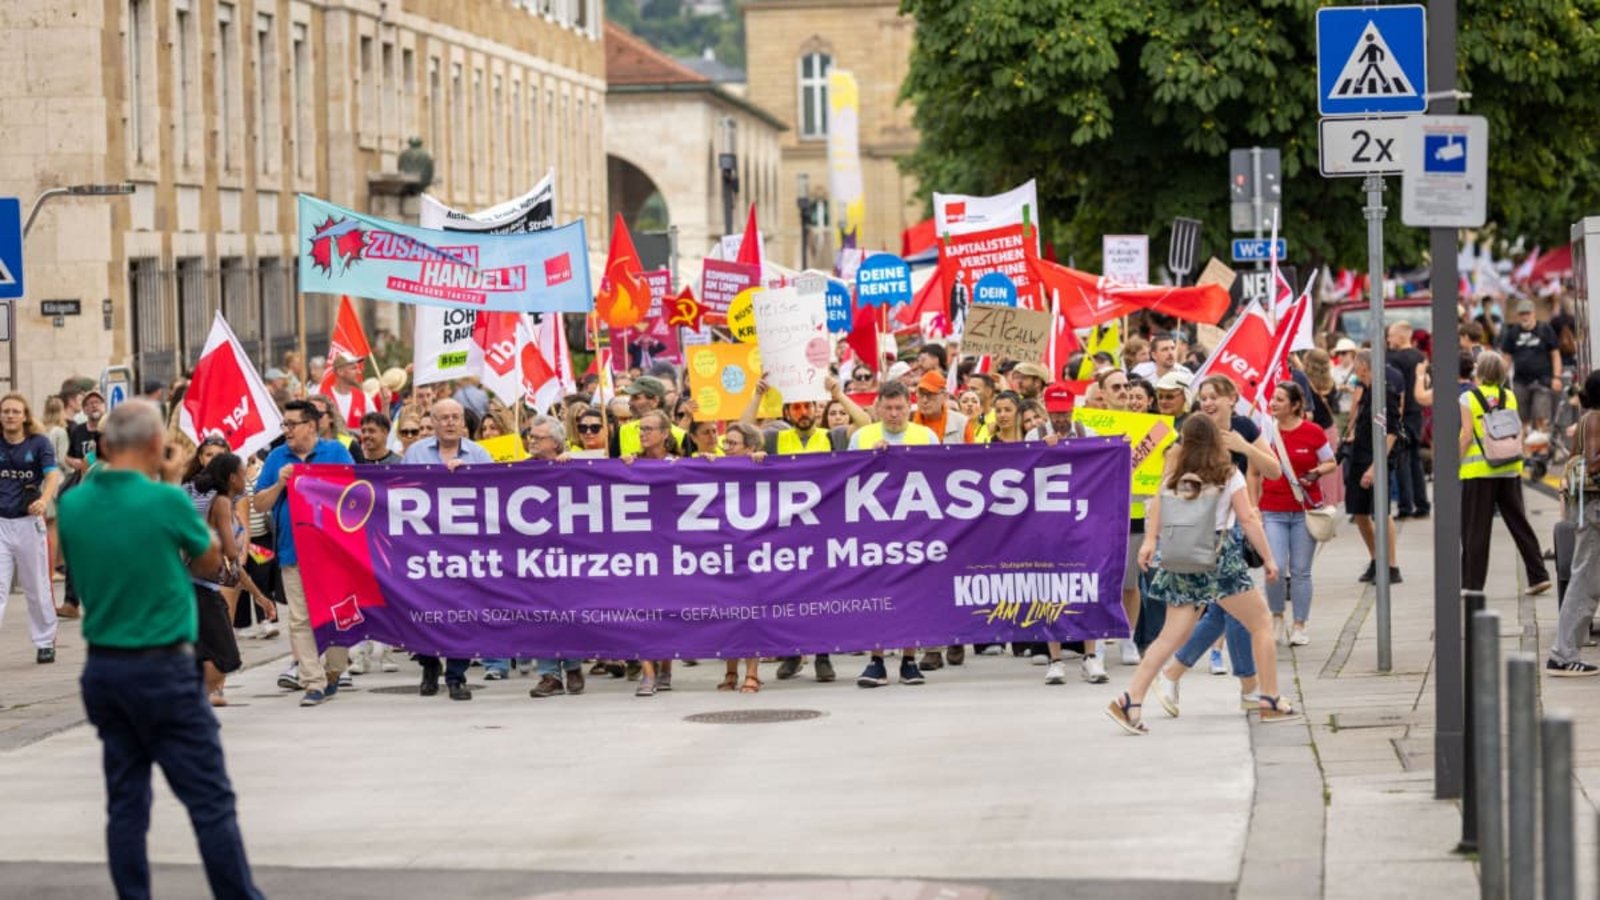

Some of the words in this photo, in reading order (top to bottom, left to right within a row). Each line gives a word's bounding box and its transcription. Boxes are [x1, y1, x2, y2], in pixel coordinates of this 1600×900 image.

[1351, 129, 1395, 163] 2x
[945, 234, 1023, 257] KAPITALISTEN
[1239, 242, 1265, 257] WC
[960, 248, 1024, 268] VERSTEHEN
[425, 262, 524, 291] HANDELN
[860, 266, 905, 282] DEINE
[860, 281, 908, 296] RENTE
[980, 287, 1008, 299] DEIN
[827, 295, 842, 307] IN
[443, 309, 475, 326] LOH
[829, 309, 847, 321] EN
[387, 484, 653, 537] REICHE
[676, 481, 822, 533] ZUR
[844, 463, 1089, 523] KASSE,
[406, 548, 504, 580] statt
[516, 546, 659, 579] Kürzen
[672, 545, 734, 575] bei
[747, 541, 814, 574] der
[826, 536, 948, 569] Masse
[953, 572, 1099, 606] KOMMUNEN
[409, 610, 443, 623] WER
[447, 609, 478, 623] DEN
[481, 608, 576, 624] SOZIALSTAAT
[581, 606, 664, 624] SCHWÄCHT
[681, 604, 768, 621] GEFÄHRDET
[772, 603, 795, 619] DIE
[799, 597, 897, 617] DEMOKRATIE.
[987, 599, 1021, 625] AM
[1021, 599, 1069, 628] LIMIT
